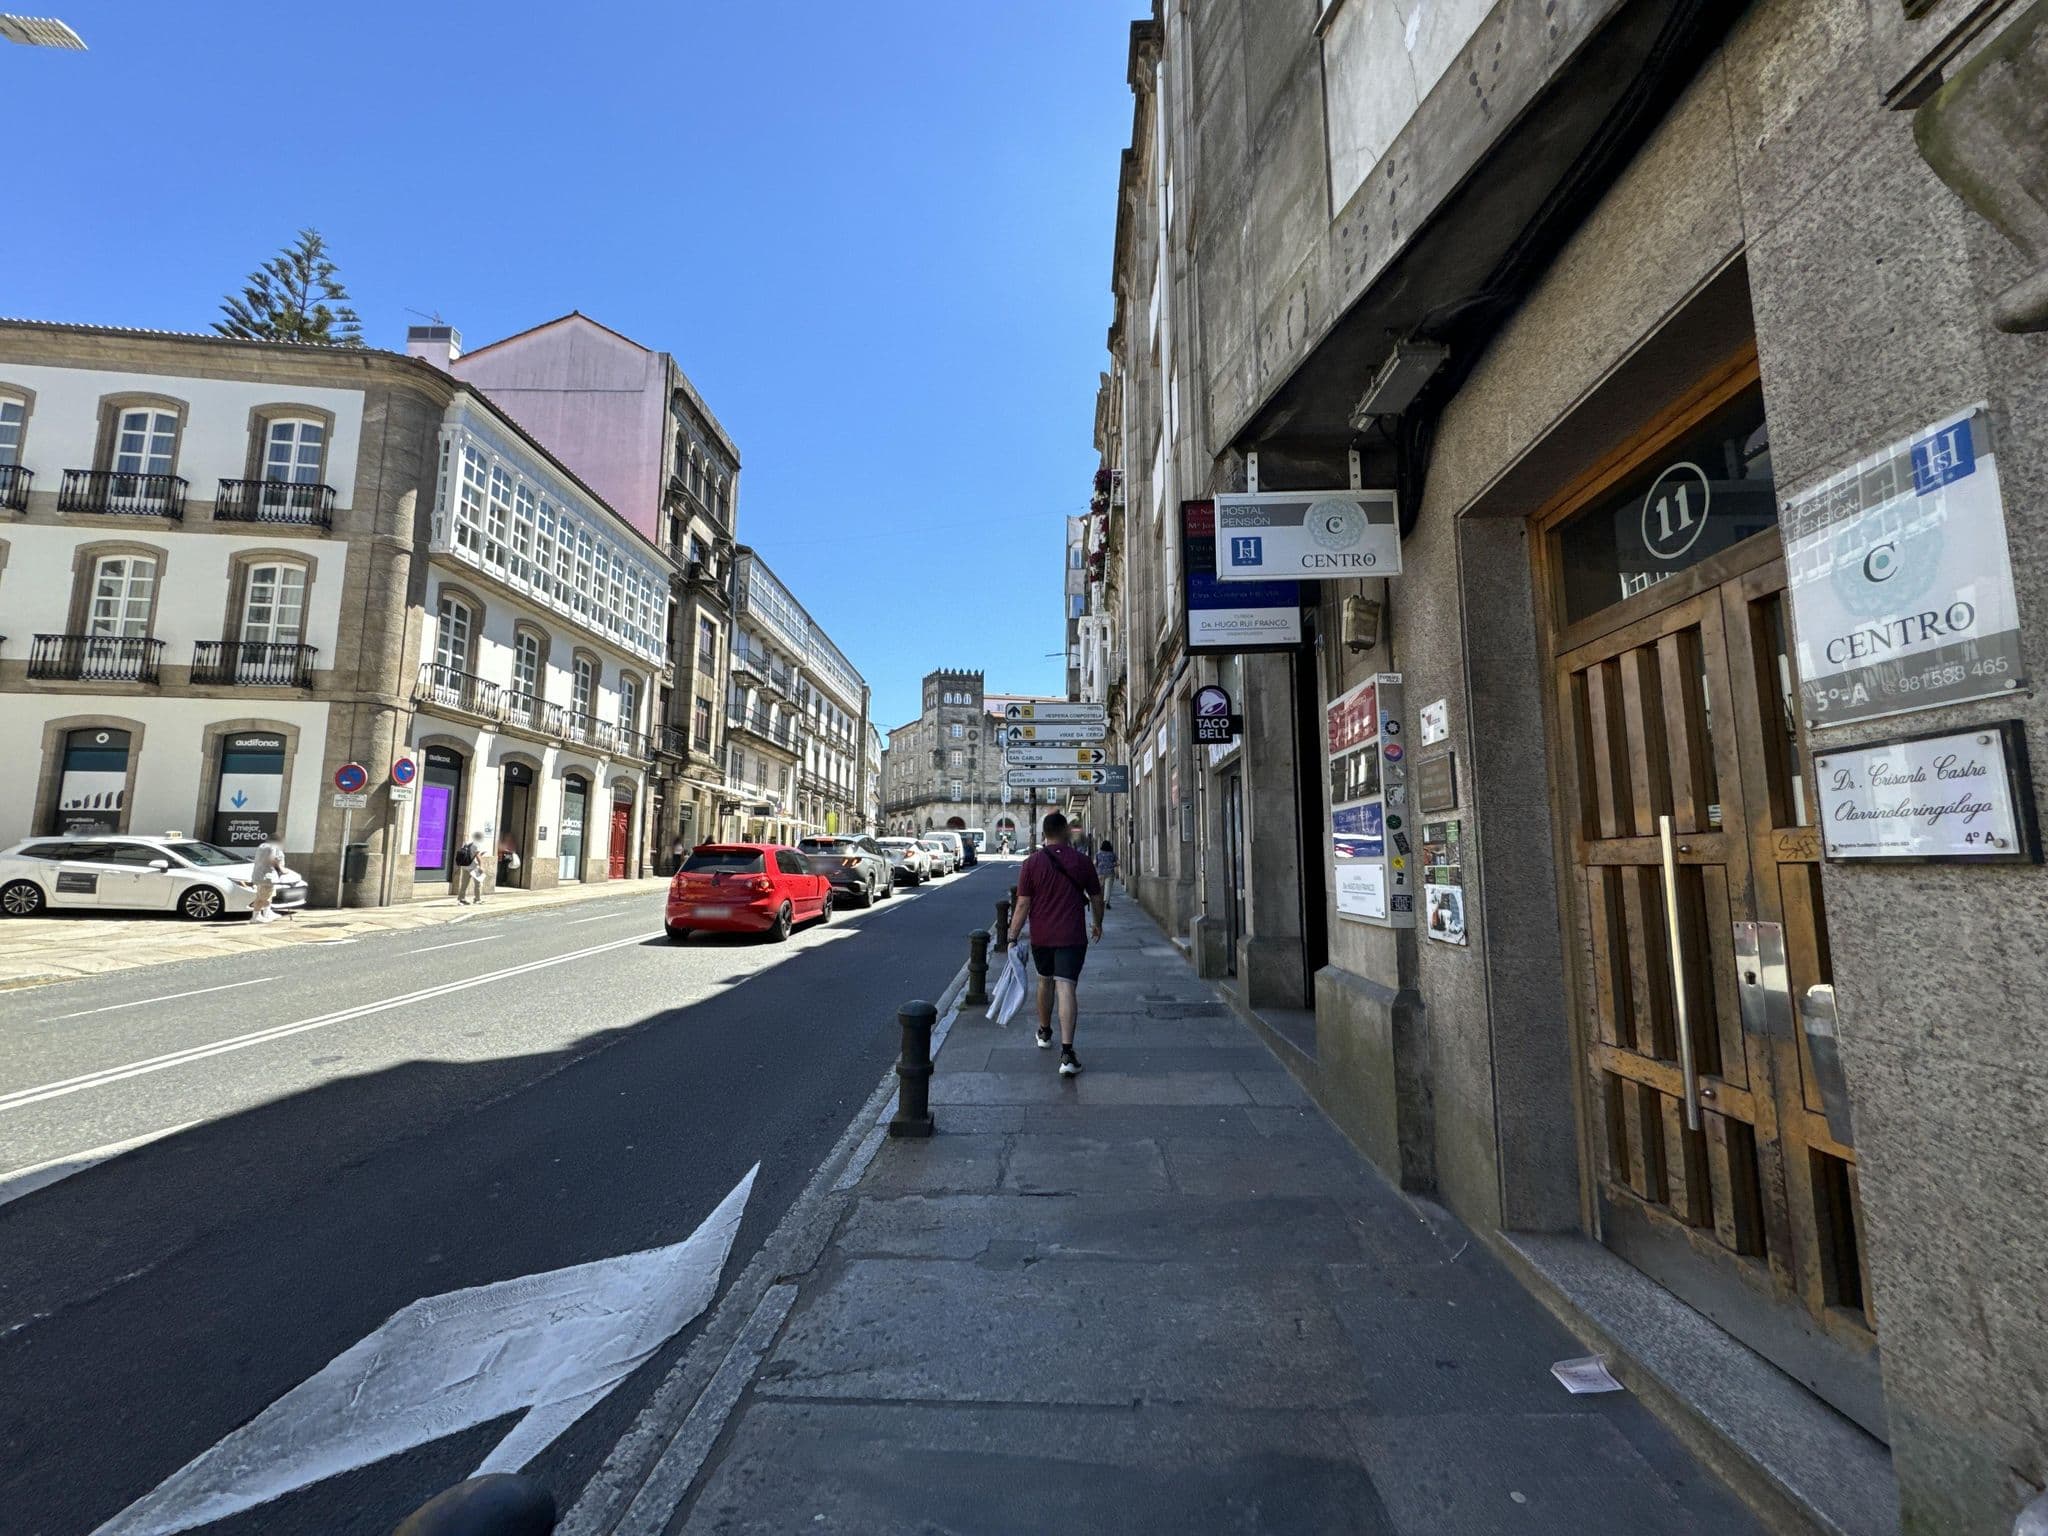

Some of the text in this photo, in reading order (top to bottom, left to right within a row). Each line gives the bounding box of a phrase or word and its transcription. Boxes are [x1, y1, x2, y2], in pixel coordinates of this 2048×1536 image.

[1221, 506, 1264, 516] HOSTAL
[1655, 483, 1694, 542] 11
[1221, 516, 1271, 526] PENSIÓN
[1301, 552, 1376, 568] CENTRO
[1826, 602, 1975, 664] CENTRO
[1971, 656, 2009, 676] 465
[1196, 718, 1230, 729] TACO
[1199, 729, 1230, 739] BELL
[1868, 763, 1928, 787] Crisanto
[1932, 754, 1988, 780] Castro
[230, 830, 268, 843] precio
[1984, 831, 1996, 844] A
